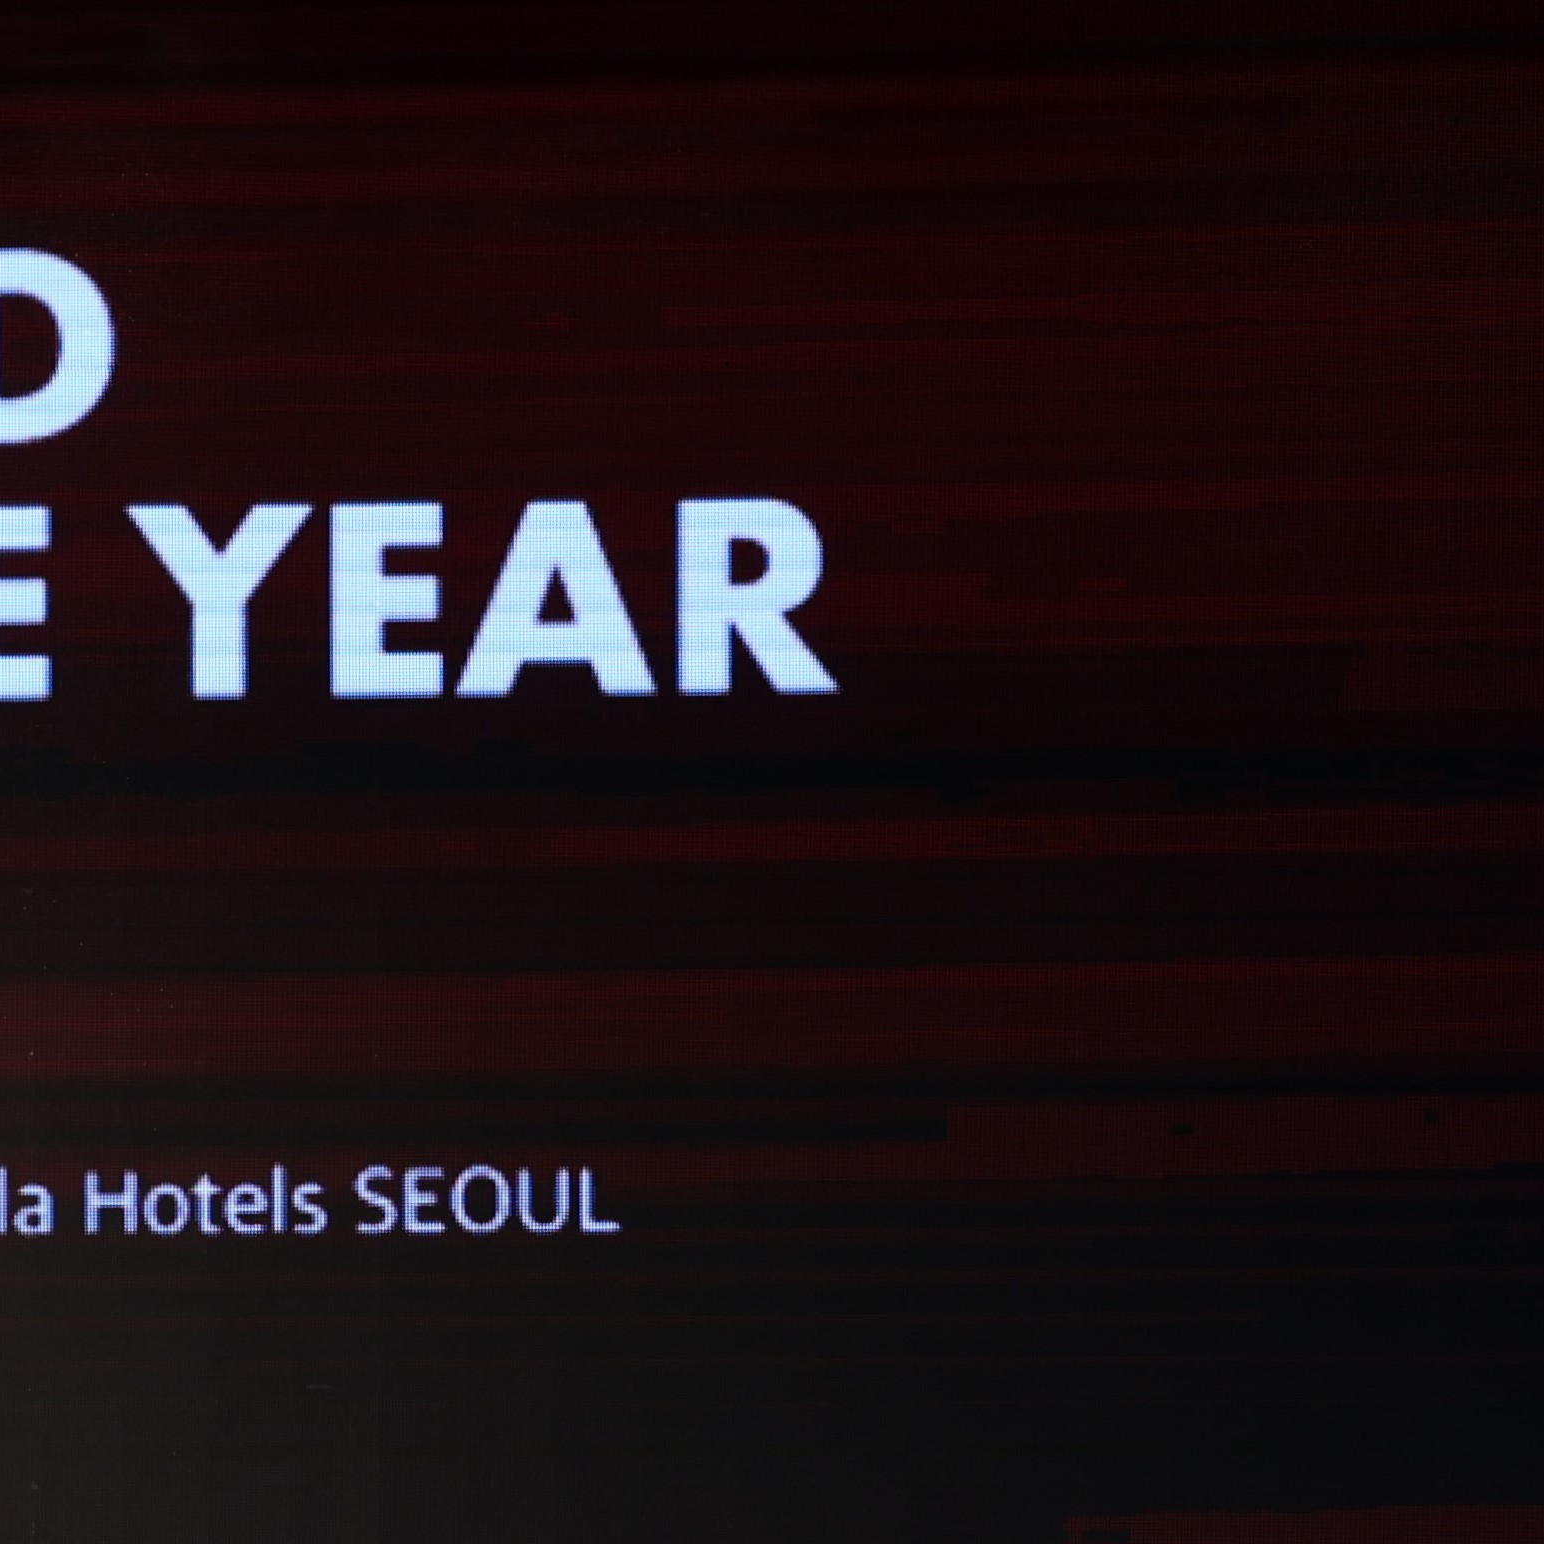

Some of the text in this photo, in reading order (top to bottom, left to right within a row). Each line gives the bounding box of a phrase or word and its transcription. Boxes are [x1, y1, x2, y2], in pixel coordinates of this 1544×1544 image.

[128, 499, 836, 698] YEAR
[85, 1164, 327, 1235] Hotels
[354, 1164, 620, 1234] SEOUL
